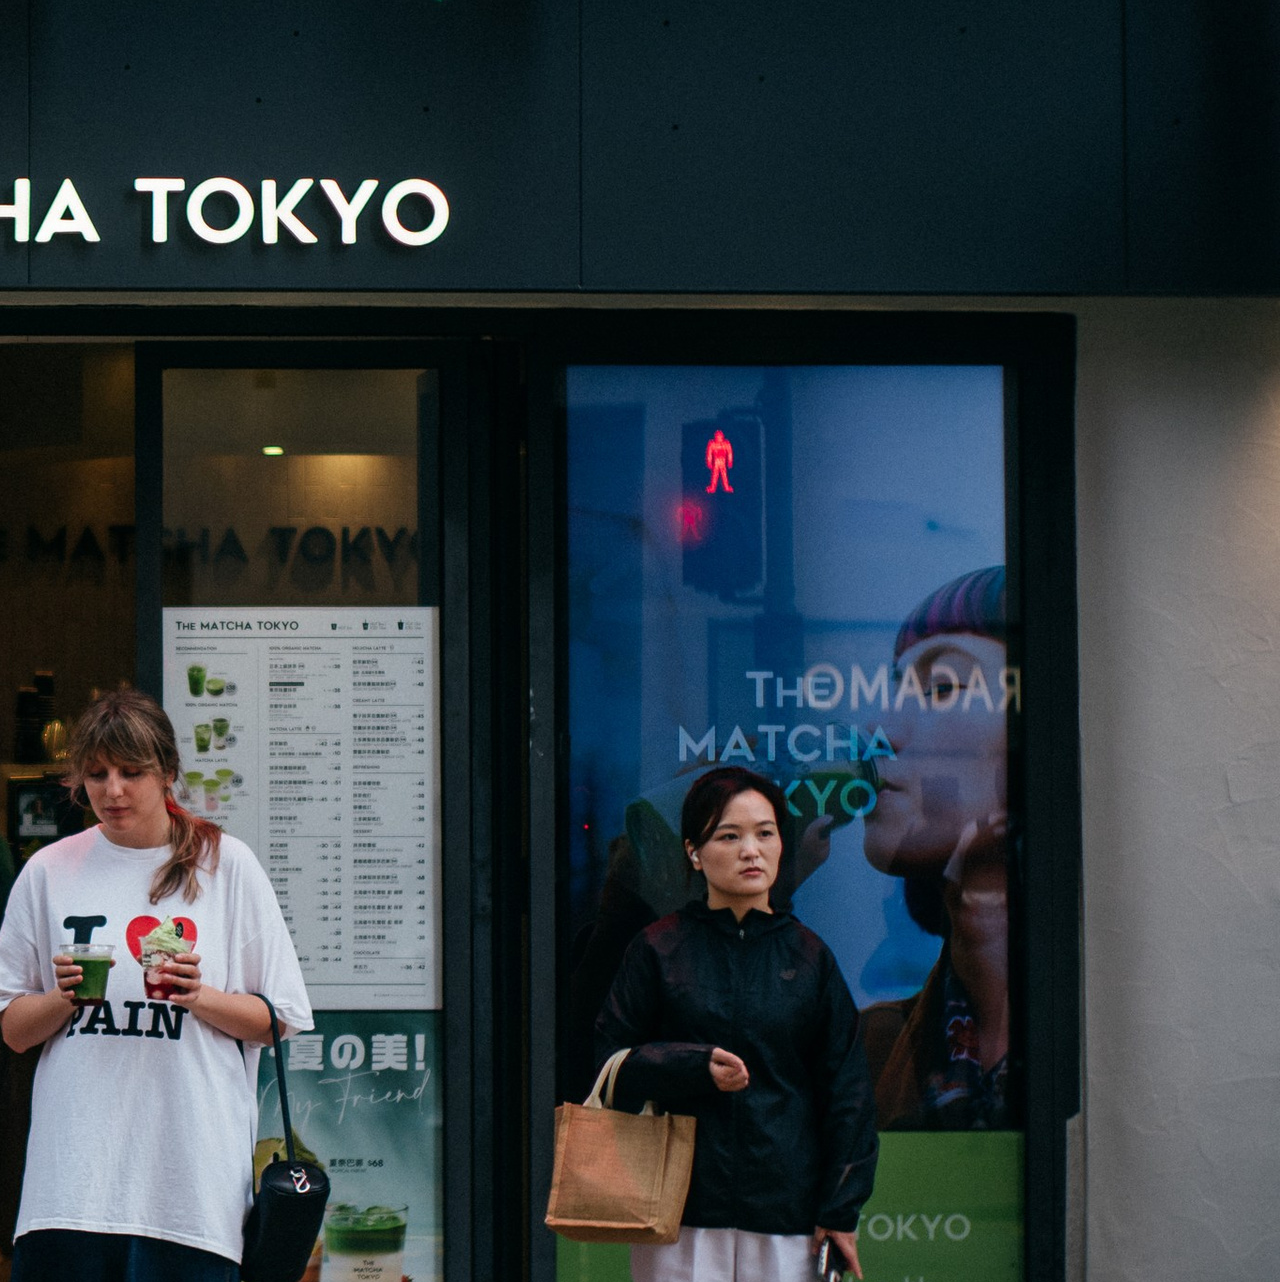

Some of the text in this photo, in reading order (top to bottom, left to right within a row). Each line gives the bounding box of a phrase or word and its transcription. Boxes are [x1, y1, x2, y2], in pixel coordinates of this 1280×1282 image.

[134, 177, 451, 247] TOKYO
[176, 621, 299, 631] THE MATCHA TOKYO
[746, 671, 832, 707] THE
[677, 724, 898, 762] MATCHA
[783, 779, 878, 817] KYO
[63, 915, 107, 951] I
[318, 1068, 431, 1125] Friend
[367, 1159, 384, 1168] $68
